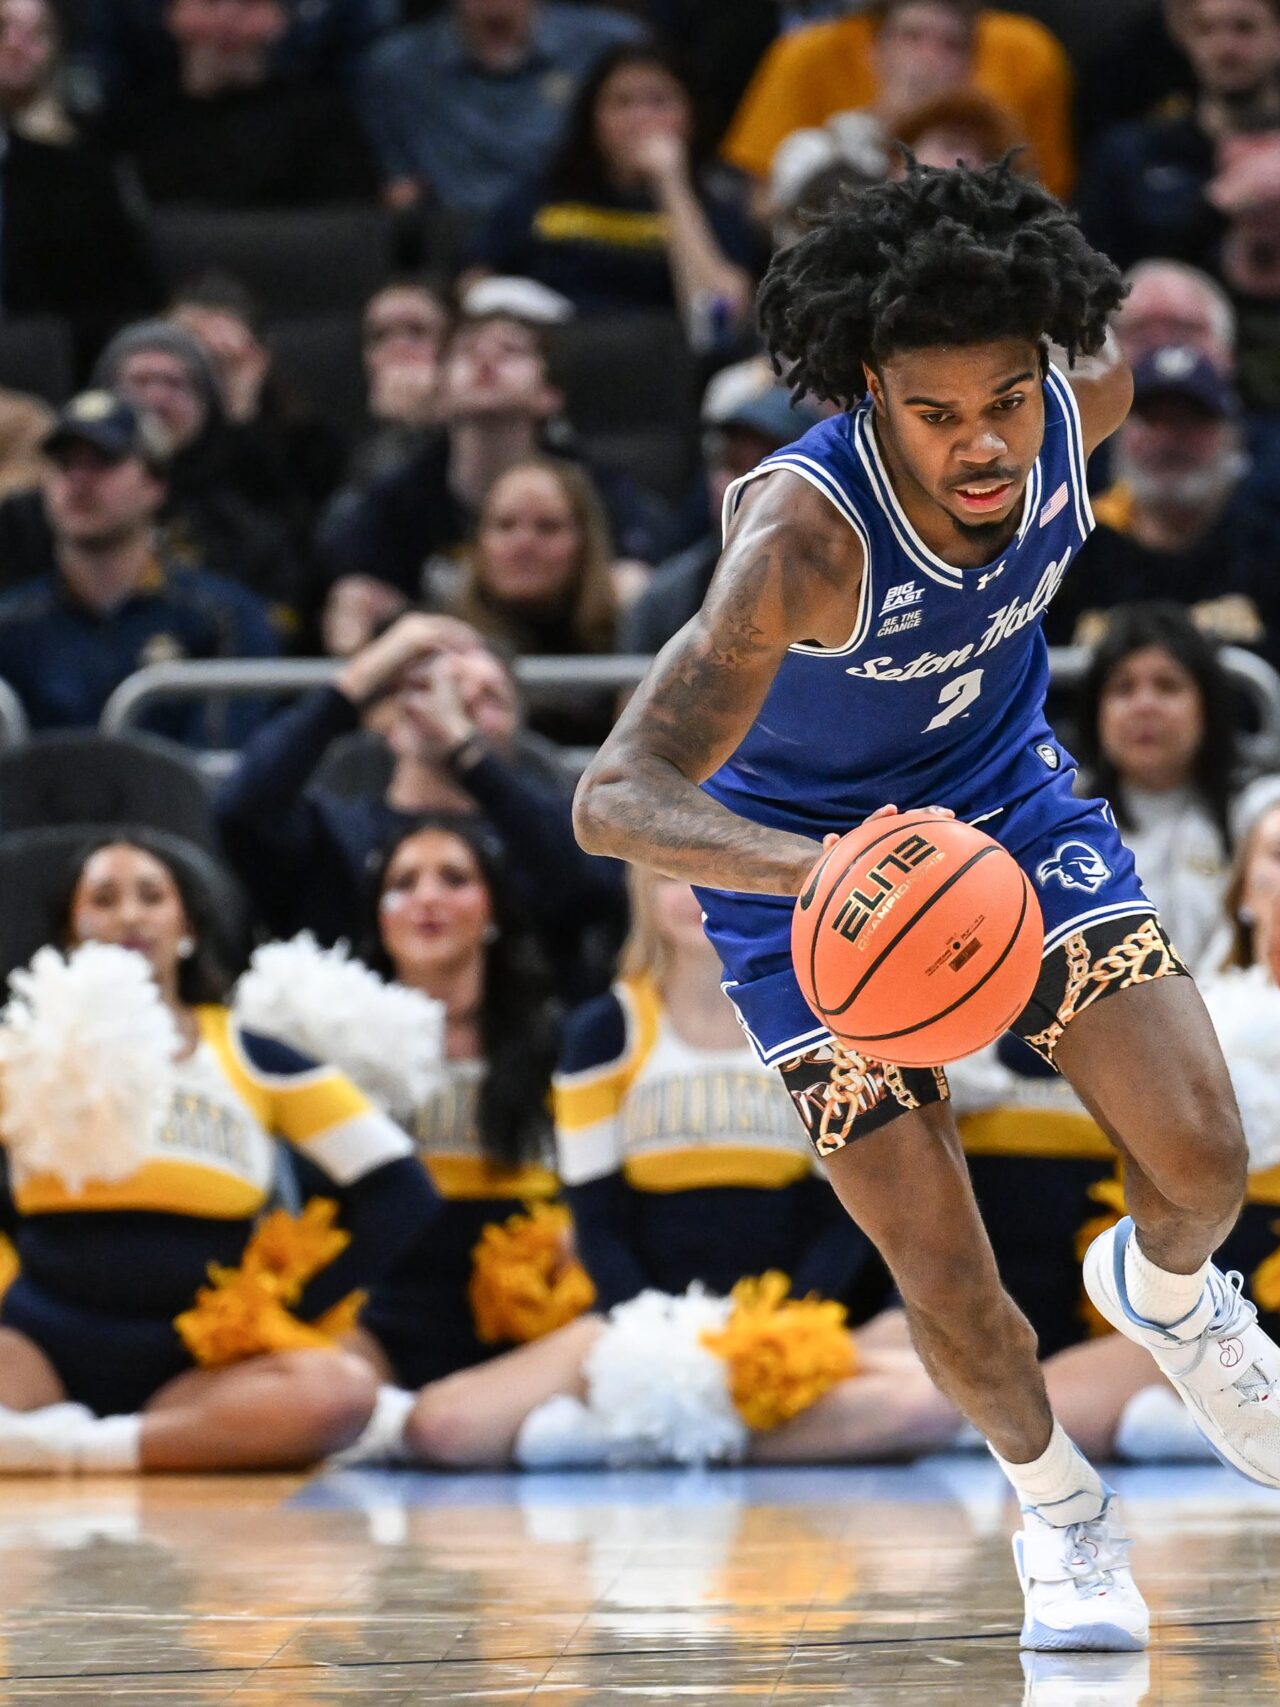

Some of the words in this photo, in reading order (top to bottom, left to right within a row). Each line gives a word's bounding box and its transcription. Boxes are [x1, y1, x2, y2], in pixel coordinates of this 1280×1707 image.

[881, 587, 925, 610] EAST
[886, 580, 915, 600] BIG
[846, 643, 974, 681] Seton
[974, 546, 1072, 657] Hall
[883, 615, 899, 627] BE
[901, 609, 922, 622] THE
[877, 617, 922, 637] CHANGE
[920, 669, 984, 734] 2
[831, 833, 937, 943] ELITE
